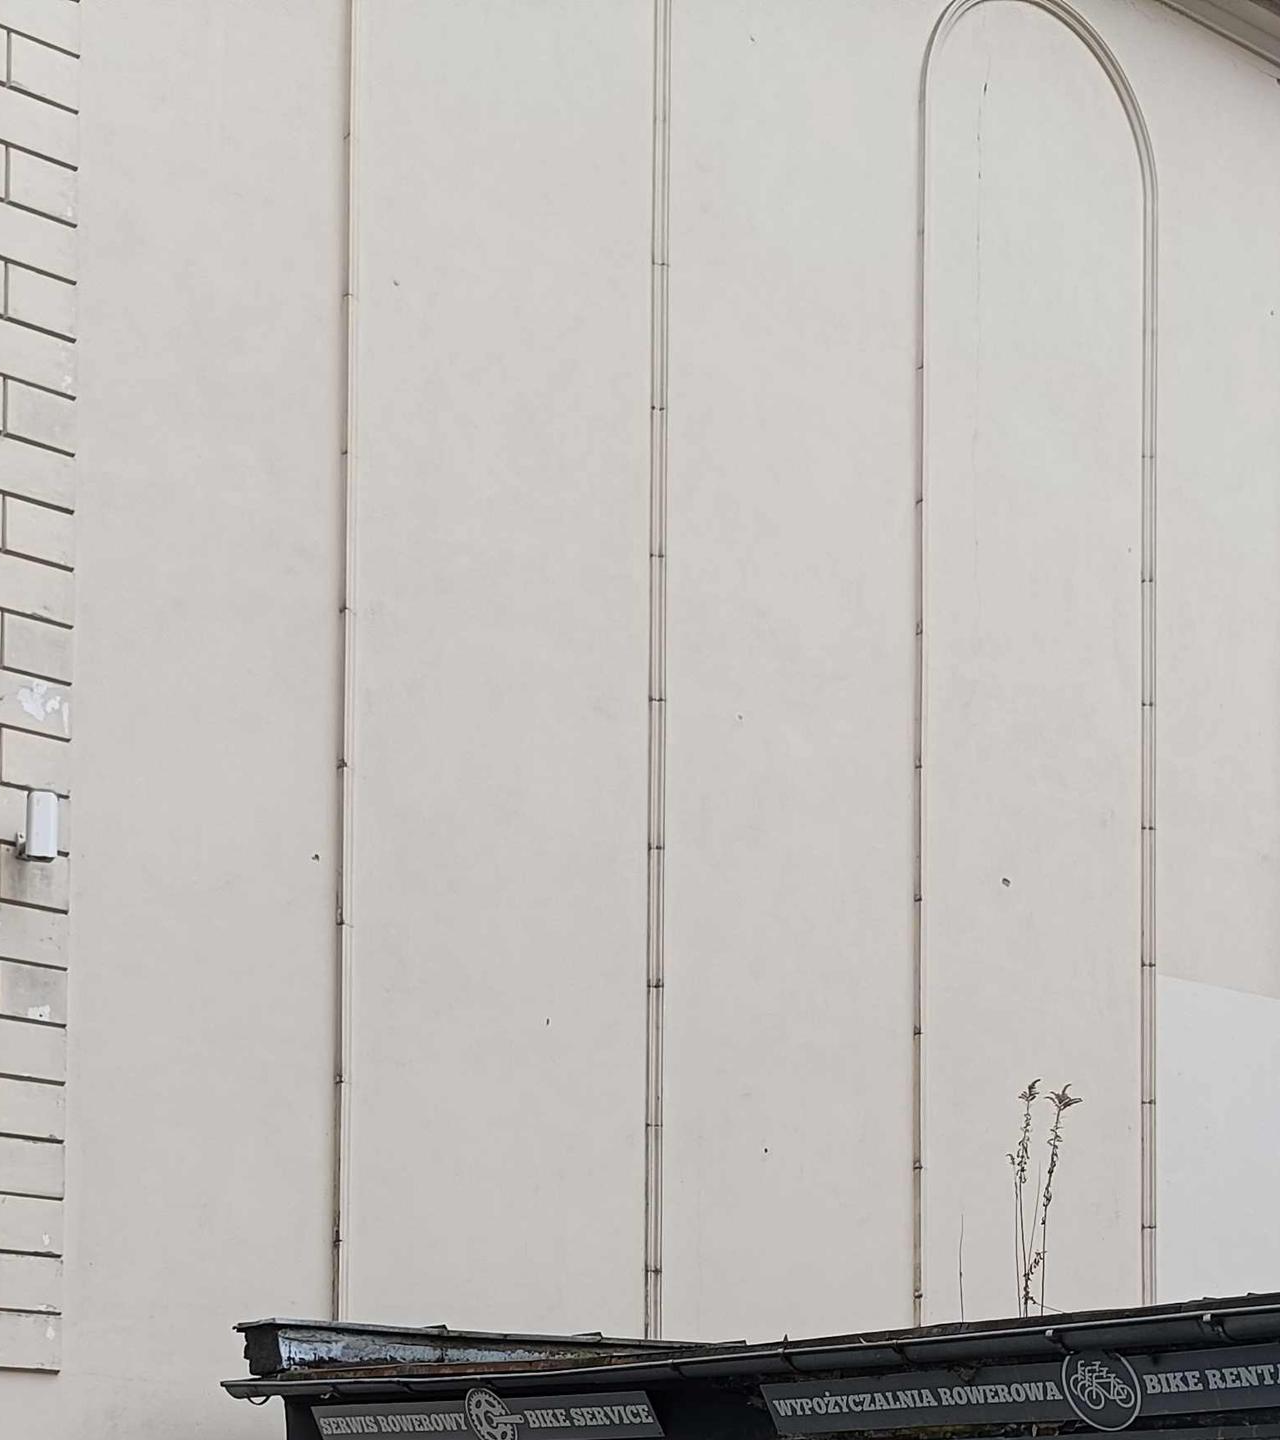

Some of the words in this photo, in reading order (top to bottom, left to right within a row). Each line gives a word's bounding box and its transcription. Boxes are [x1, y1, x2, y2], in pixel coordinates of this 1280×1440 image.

[1143, 1370, 1204, 1394] BIKE
[773, 1388, 938, 1417] WYPOŻYCZALNIA
[938, 1381, 1063, 1407] ROWEROWA
[319, 1415, 379, 1435] SERWIS
[376, 1412, 468, 1432] ROWEROWY
[523, 1408, 571, 1429] BIKE
[570, 1404, 655, 1427] SERVICE
